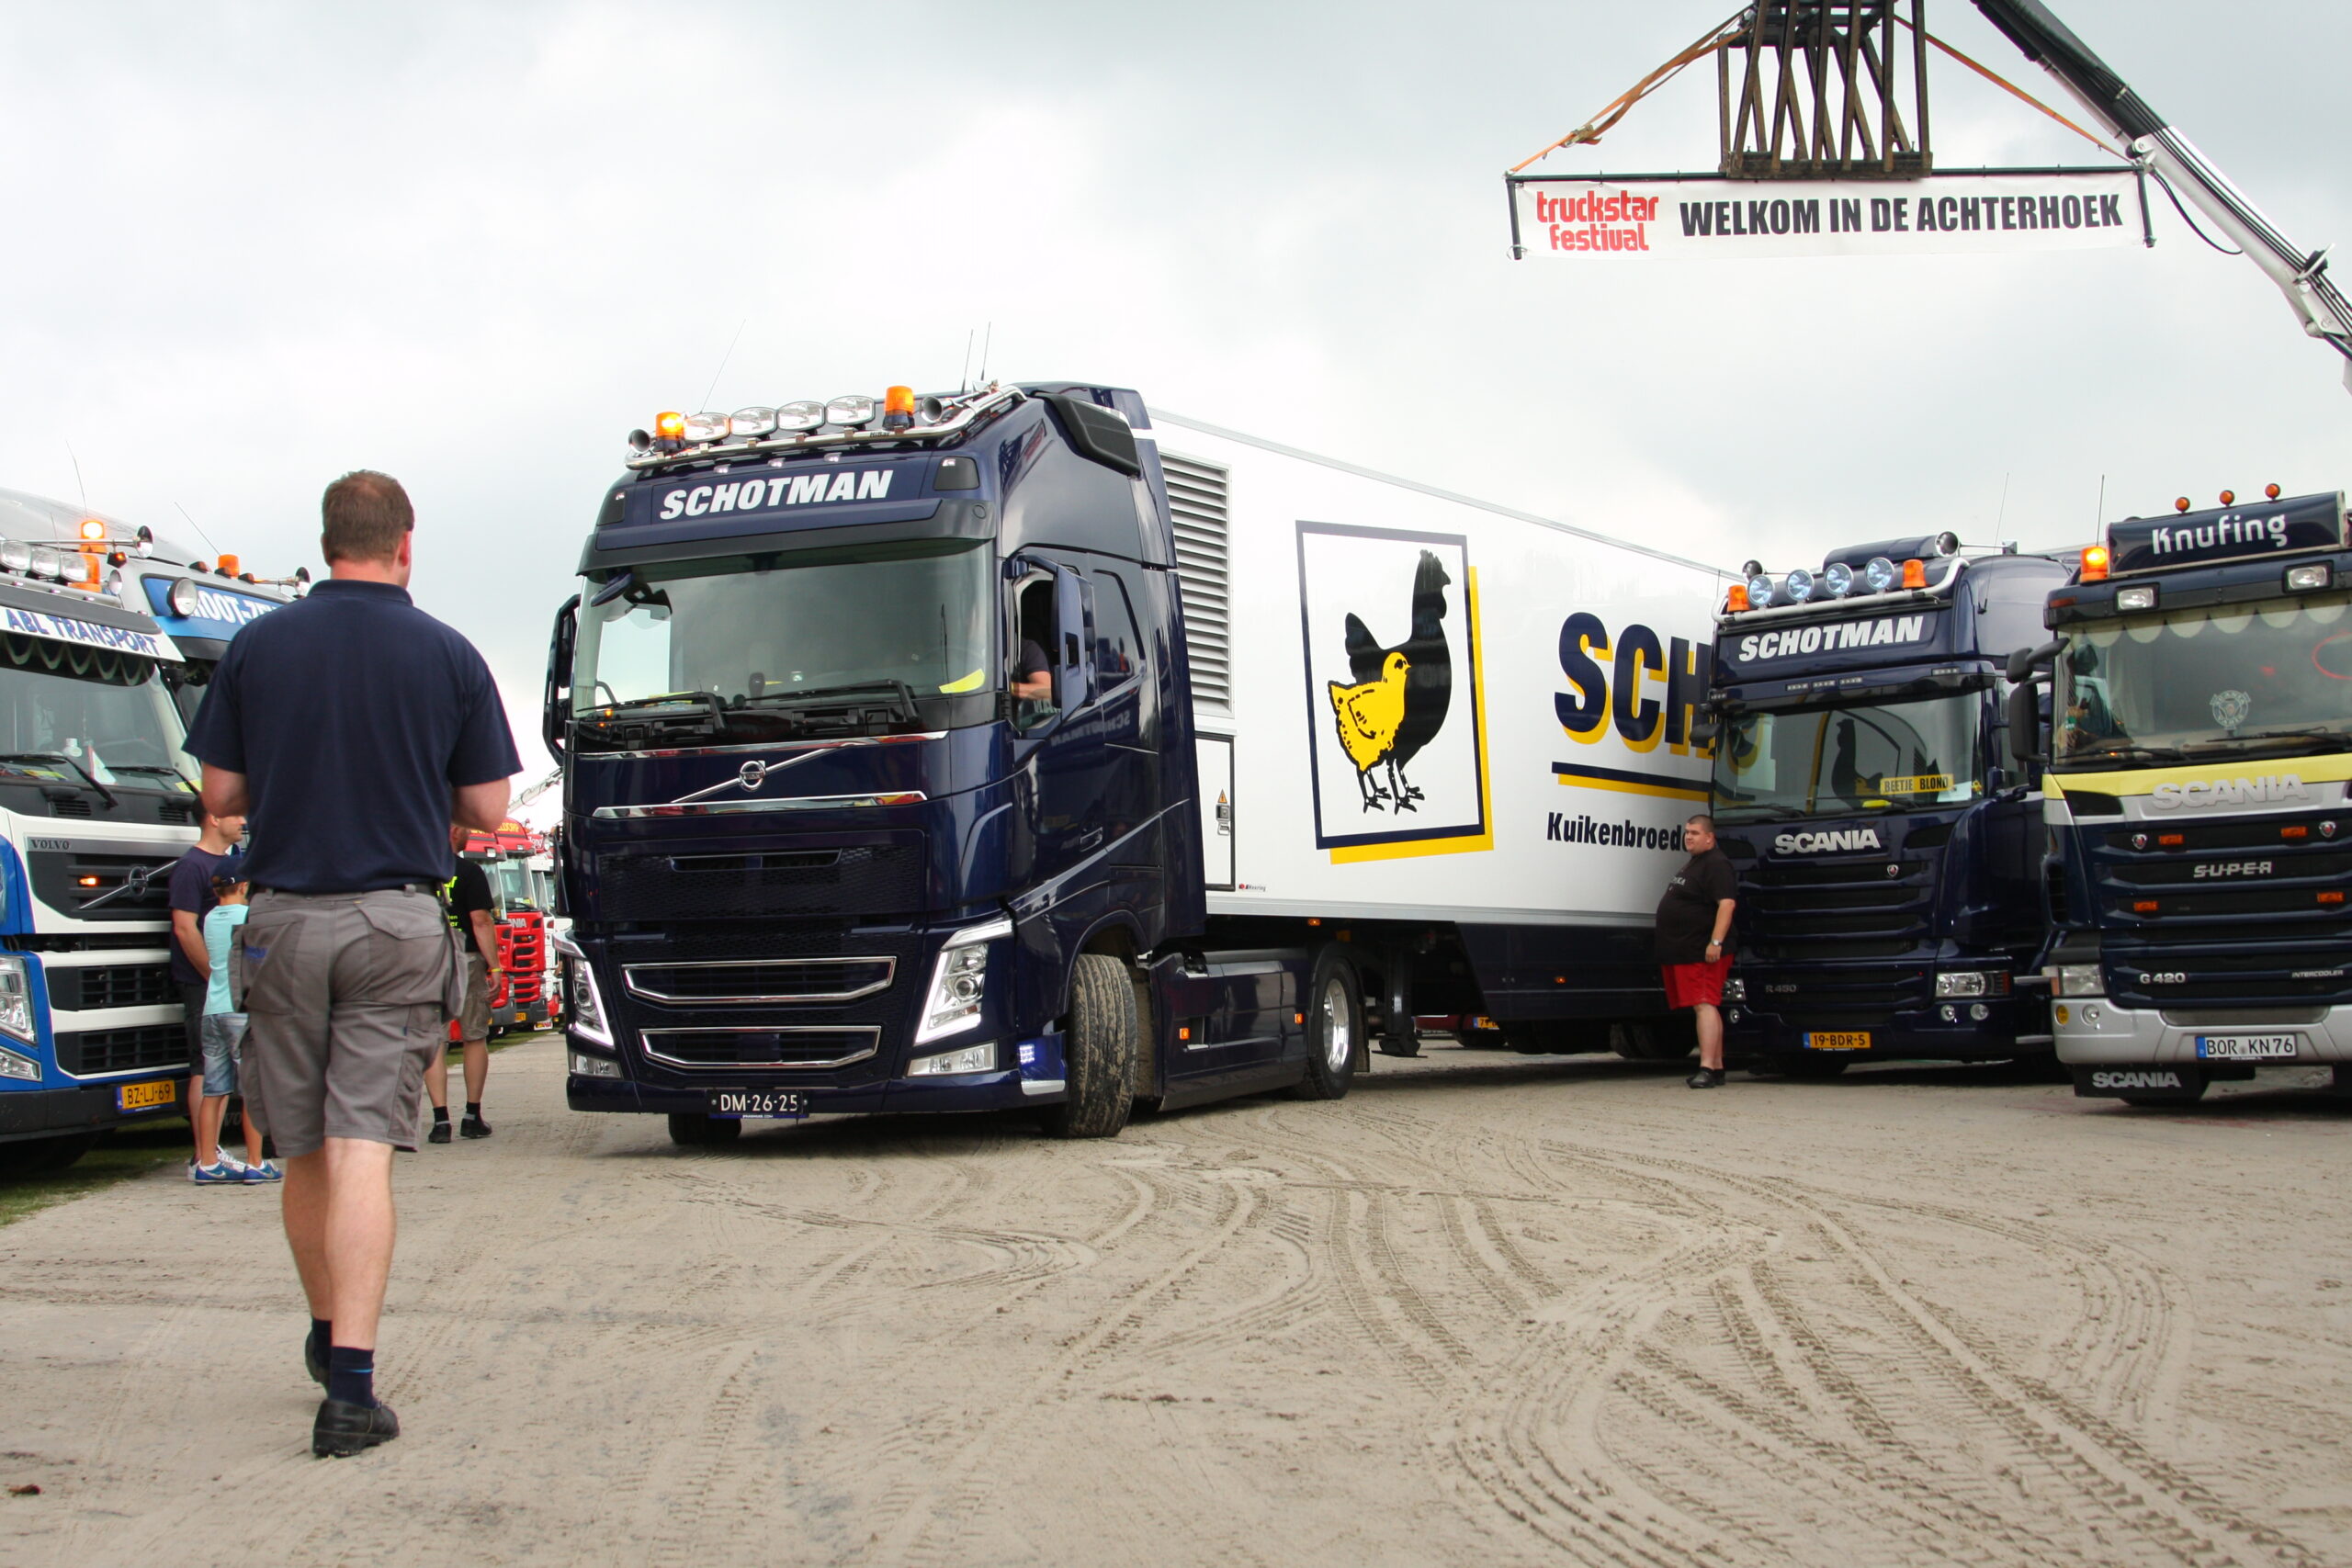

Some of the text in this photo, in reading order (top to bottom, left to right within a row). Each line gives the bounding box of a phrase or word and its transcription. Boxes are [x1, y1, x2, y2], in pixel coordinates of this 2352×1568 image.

[1537, 190, 1658, 222] truckstar
[1679, 193, 2124, 237] WELKOM IN DE ACHTERHOEK
[1549, 223, 1650, 251] festival
[659, 469, 894, 520] SCHOTMAN
[2152, 513, 2288, 555] Knufing
[7, 608, 160, 657] ABL TRANSPORT
[1738, 615, 1924, 662] SCHOTMAN
[1884, 774, 1949, 793] BEETJE BLOND
[2152, 774, 2311, 810] SCANIA
[31, 839, 70, 851] VOLVO
[1774, 829, 1882, 855] SCANIA
[2193, 861, 2273, 878] SUPER
[2140, 972, 2187, 984] G 420
[2291, 969, 2344, 978] INTERCOOLER
[1814, 1034, 1866, 1046] 19-BDR-5
[2207, 1039, 2238, 1055] BOR
[2248, 1038, 2270, 1055] KN
[2273, 1037, 2294, 1054] 76
[2092, 1071, 2182, 1089] SCANIA
